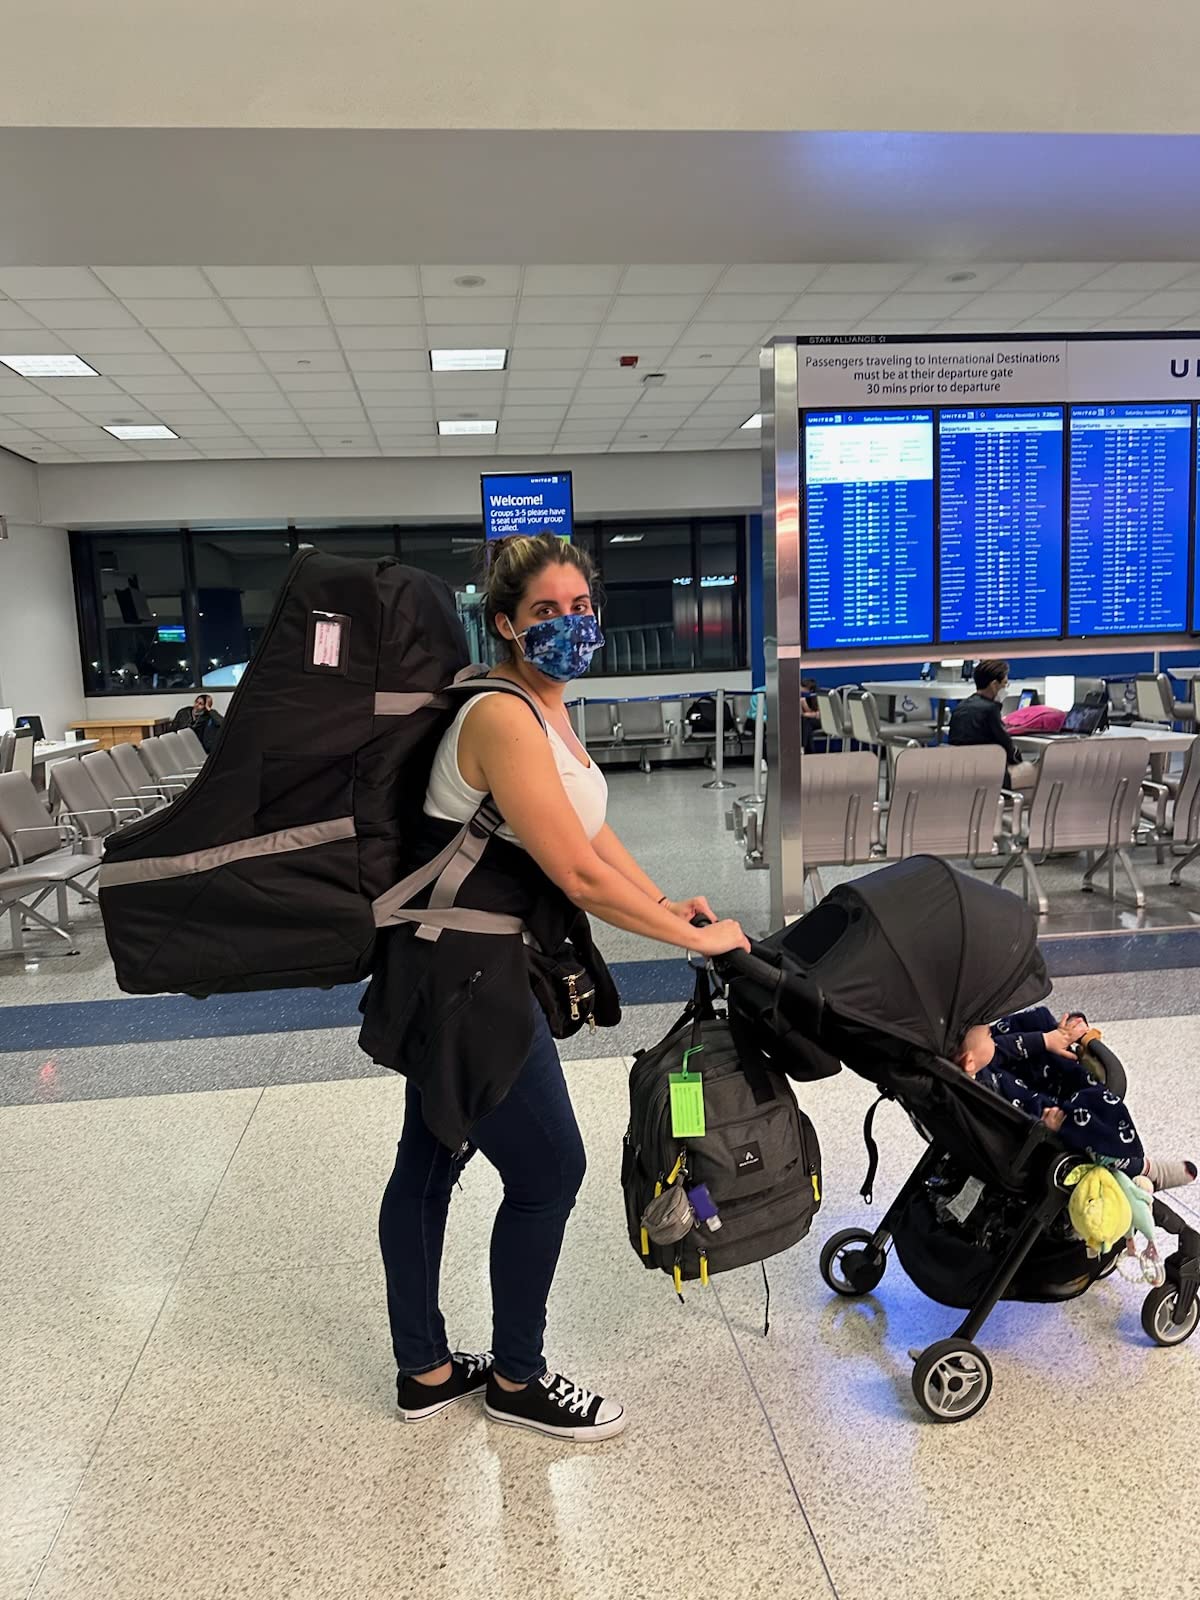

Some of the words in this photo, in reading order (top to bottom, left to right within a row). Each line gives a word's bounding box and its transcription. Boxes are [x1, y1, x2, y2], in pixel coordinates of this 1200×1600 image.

[808, 336, 831, 344] STAR
[833, 335, 876, 344] ALLIANCE
[805, 356, 864, 369] Passengers
[866, 355, 912, 368] traveling
[914, 355, 926, 365] to
[928, 353, 994, 365] International
[996, 352, 1060, 364] Destinations
[854, 371, 880, 380] must
[882, 369, 896, 380] be
[898, 370, 908, 379] at
[911, 368, 935, 379] their
[937, 368, 989, 380] departure
[990, 368, 1014, 380] gate
[1170, 359, 1200, 378] U
[866, 383, 880, 394] 30
[882, 382, 907, 393] mins
[909, 382, 935, 396] prior
[937, 383, 948, 393] to
[950, 382, 1001, 394] departure
[490, 494, 543, 507] Welcome!
[490, 509, 514, 518] Groups
[514, 508, 526, 517] 3-5
[527, 508, 548, 517] please
[549, 507, 566, 515] have
[511, 516, 526, 524] until
[527, 516, 543, 525] your
[543, 516, 563, 524] group
[498, 524, 519, 532] called.
